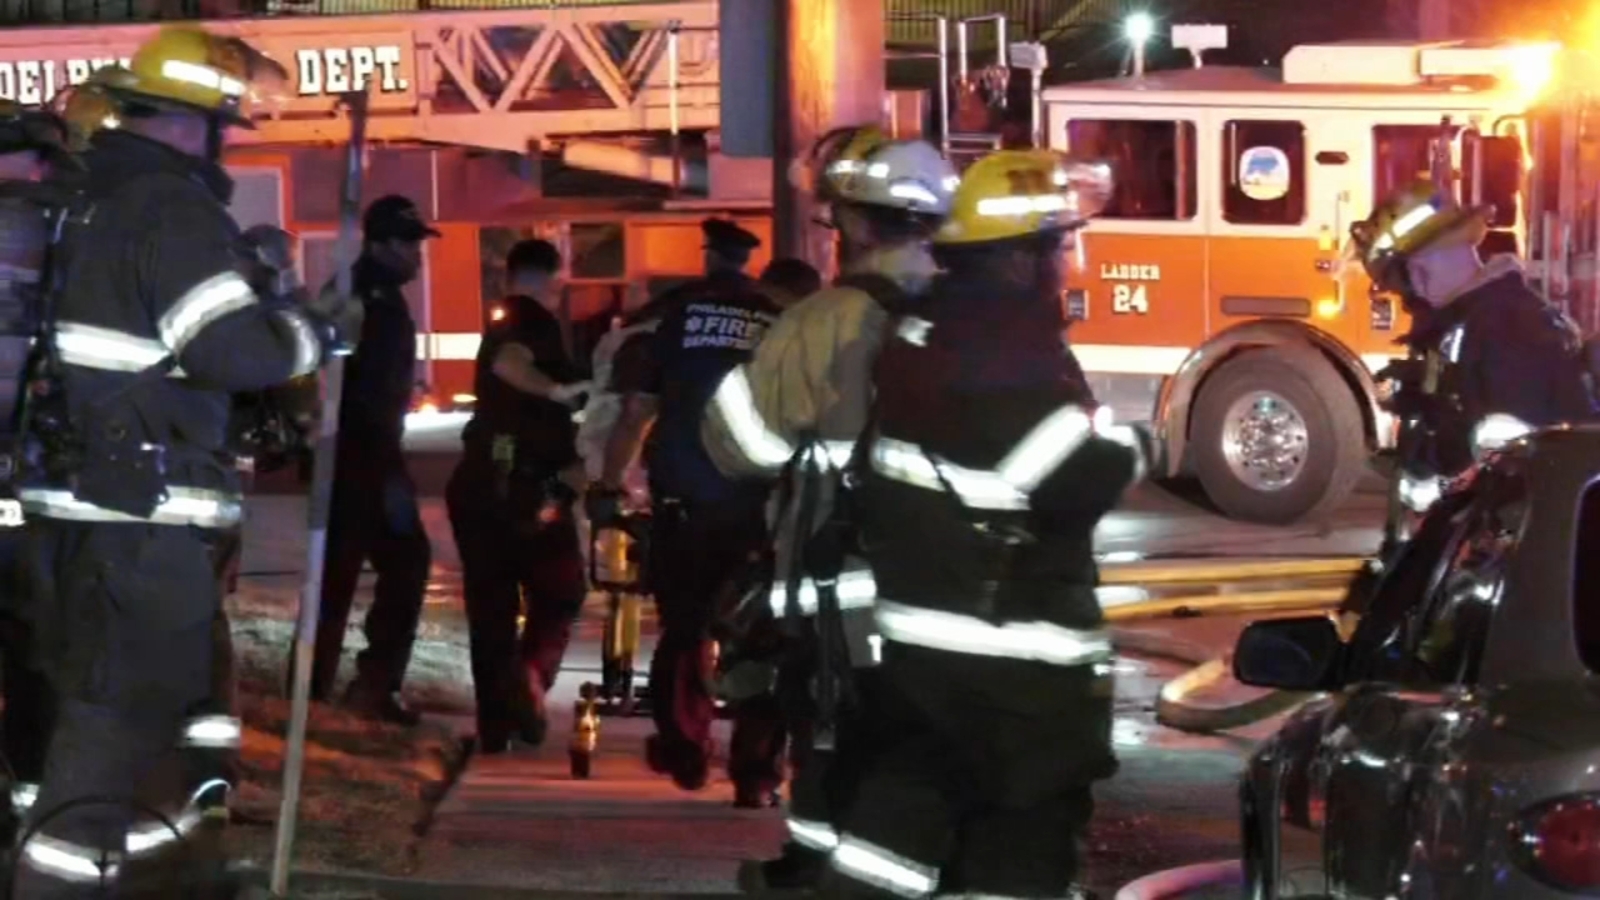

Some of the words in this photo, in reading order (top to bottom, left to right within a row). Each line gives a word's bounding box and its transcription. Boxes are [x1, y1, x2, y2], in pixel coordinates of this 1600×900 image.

[296, 46, 409, 94] DEPT.
[1101, 263, 1160, 280] LADDER
[1113, 284, 1148, 313] 24
